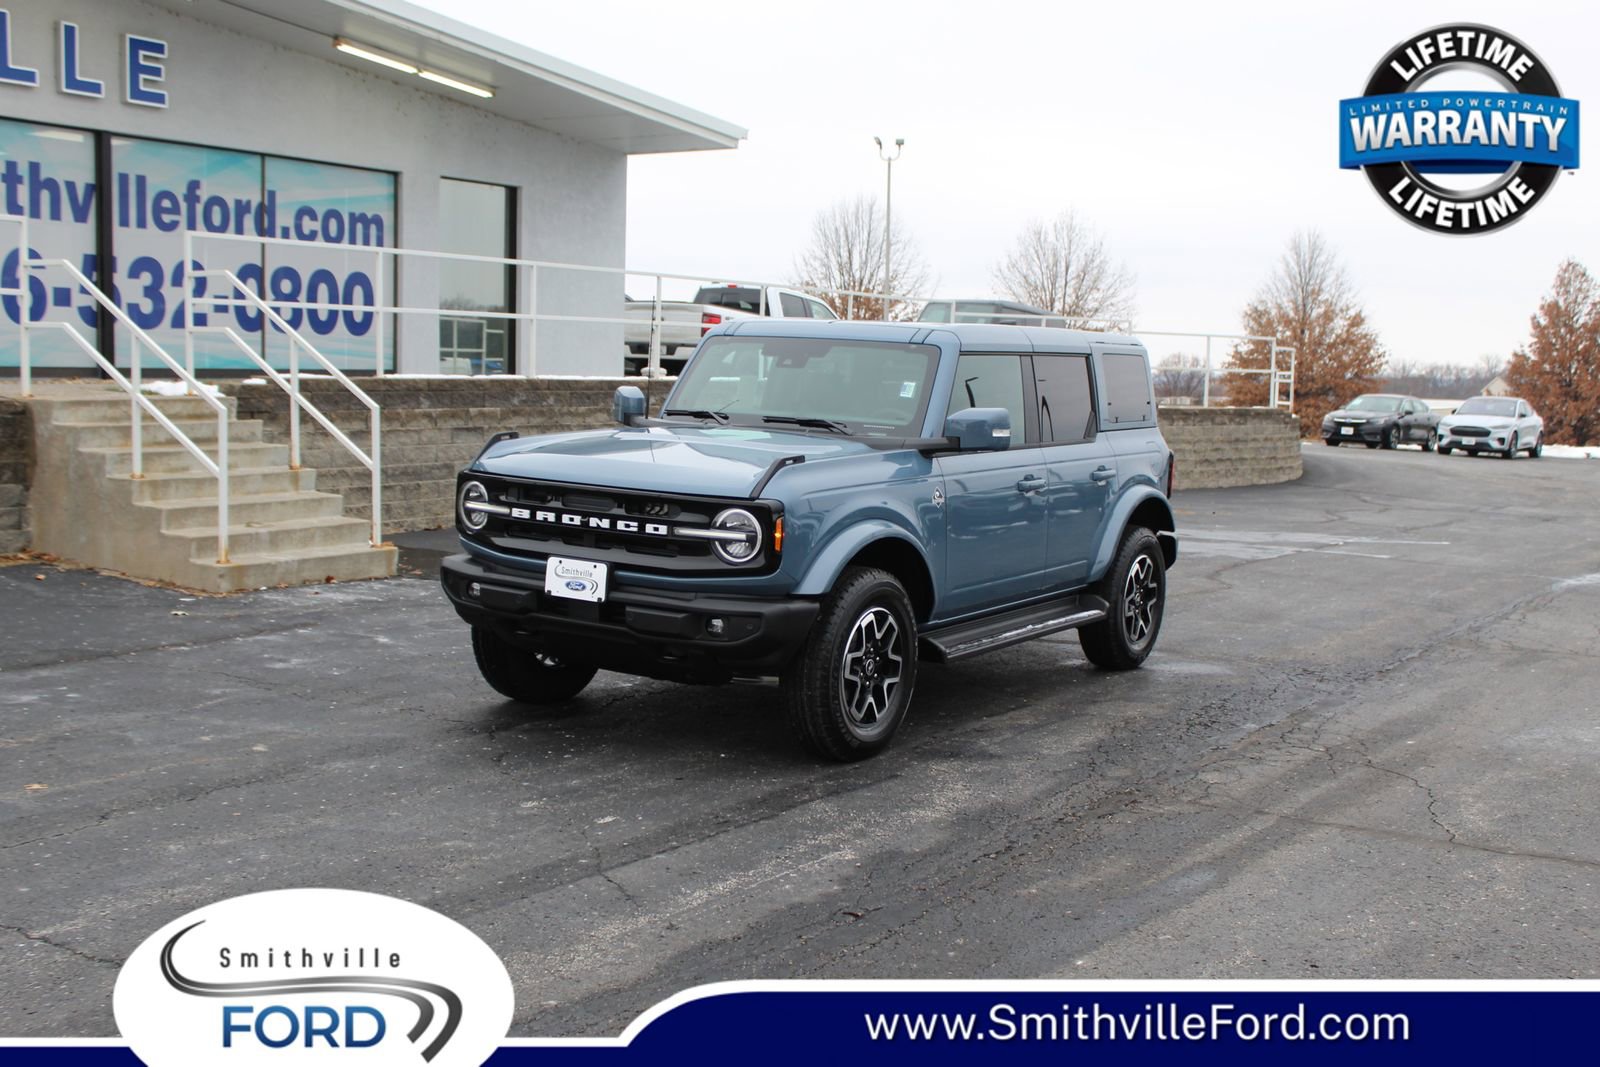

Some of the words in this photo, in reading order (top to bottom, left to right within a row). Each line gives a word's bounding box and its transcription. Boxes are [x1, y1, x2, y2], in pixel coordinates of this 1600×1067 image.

[1, 160, 385, 248] thvlleford.com
[511, 507, 668, 535] BRONCO
[561, 566, 593, 578] Smithville
